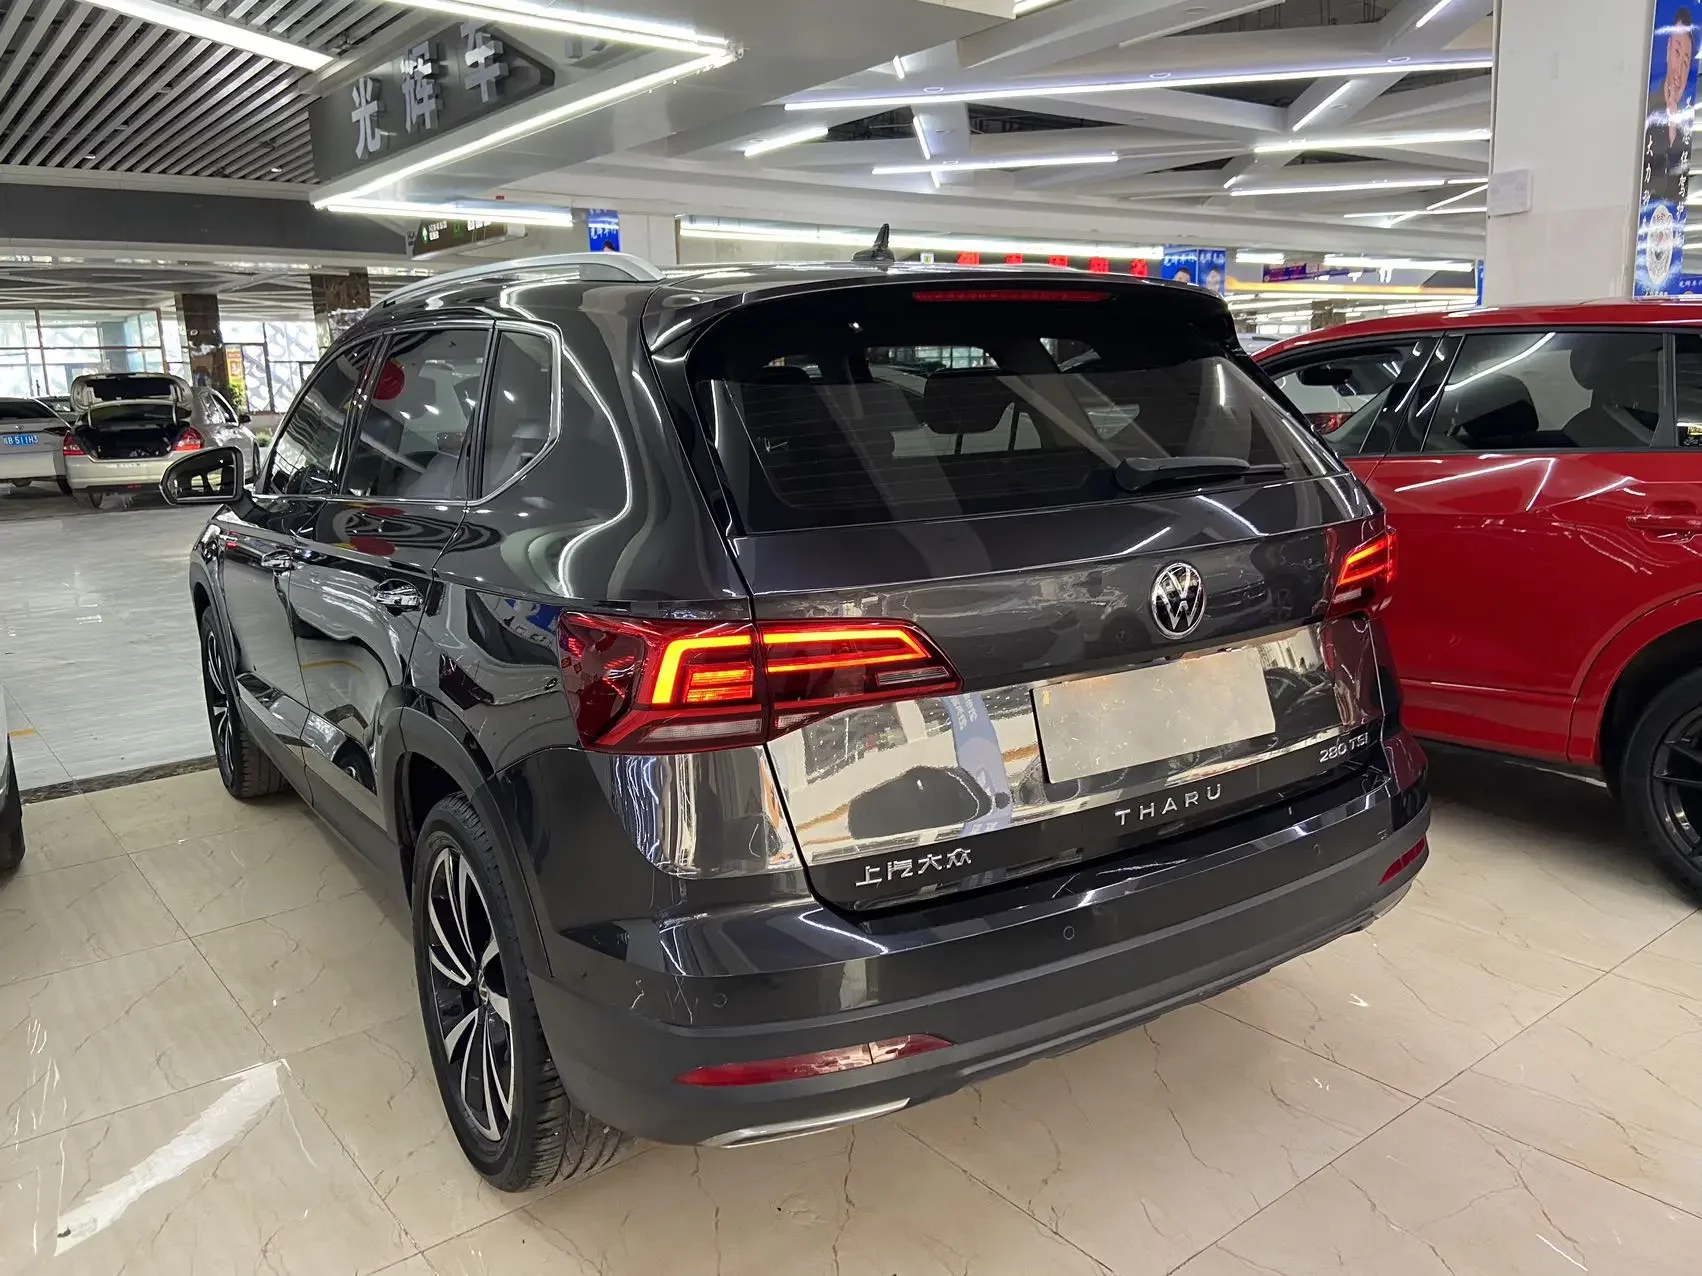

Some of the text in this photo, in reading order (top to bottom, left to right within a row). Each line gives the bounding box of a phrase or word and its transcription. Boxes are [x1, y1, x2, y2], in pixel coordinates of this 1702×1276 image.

[1319, 731, 1369, 763] 280 TSI
[1114, 783, 1221, 826] THARU
[855, 848, 971, 887] 上汽大众
